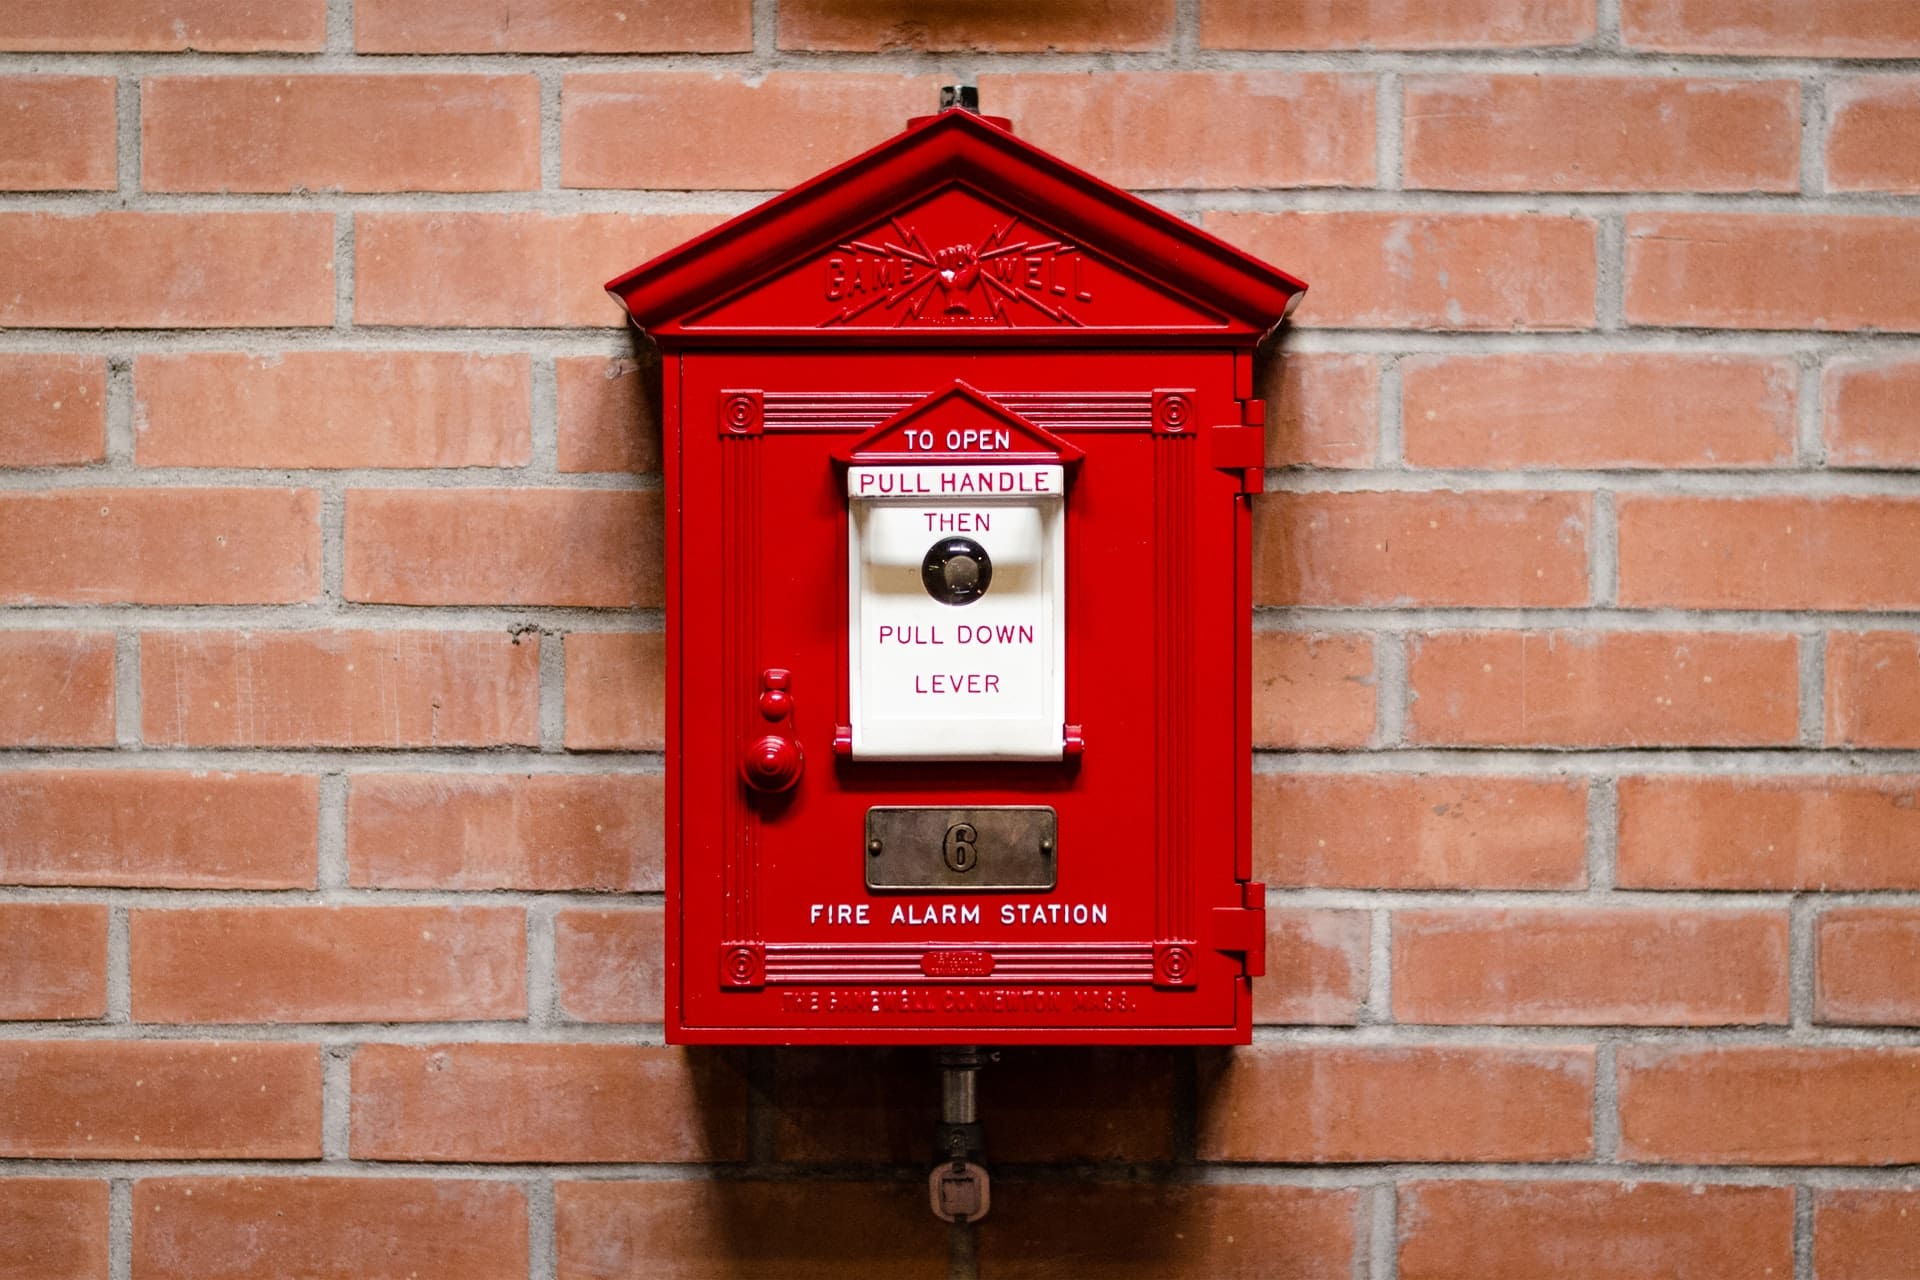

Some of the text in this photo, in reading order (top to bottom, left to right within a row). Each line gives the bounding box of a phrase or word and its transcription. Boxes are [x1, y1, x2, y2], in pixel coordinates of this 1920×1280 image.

[825, 257, 1093, 302] GAME WELL
[904, 430, 1010, 450] TO OPEN
[860, 472, 1050, 493] PULL HANDLE
[924, 513, 990, 532] THEN
[879, 625, 1034, 645] PULL DOWN
[915, 674, 1000, 693] LEVER
[943, 822, 978, 873] 6
[810, 903, 1108, 925] FIRE ALARM STATION
